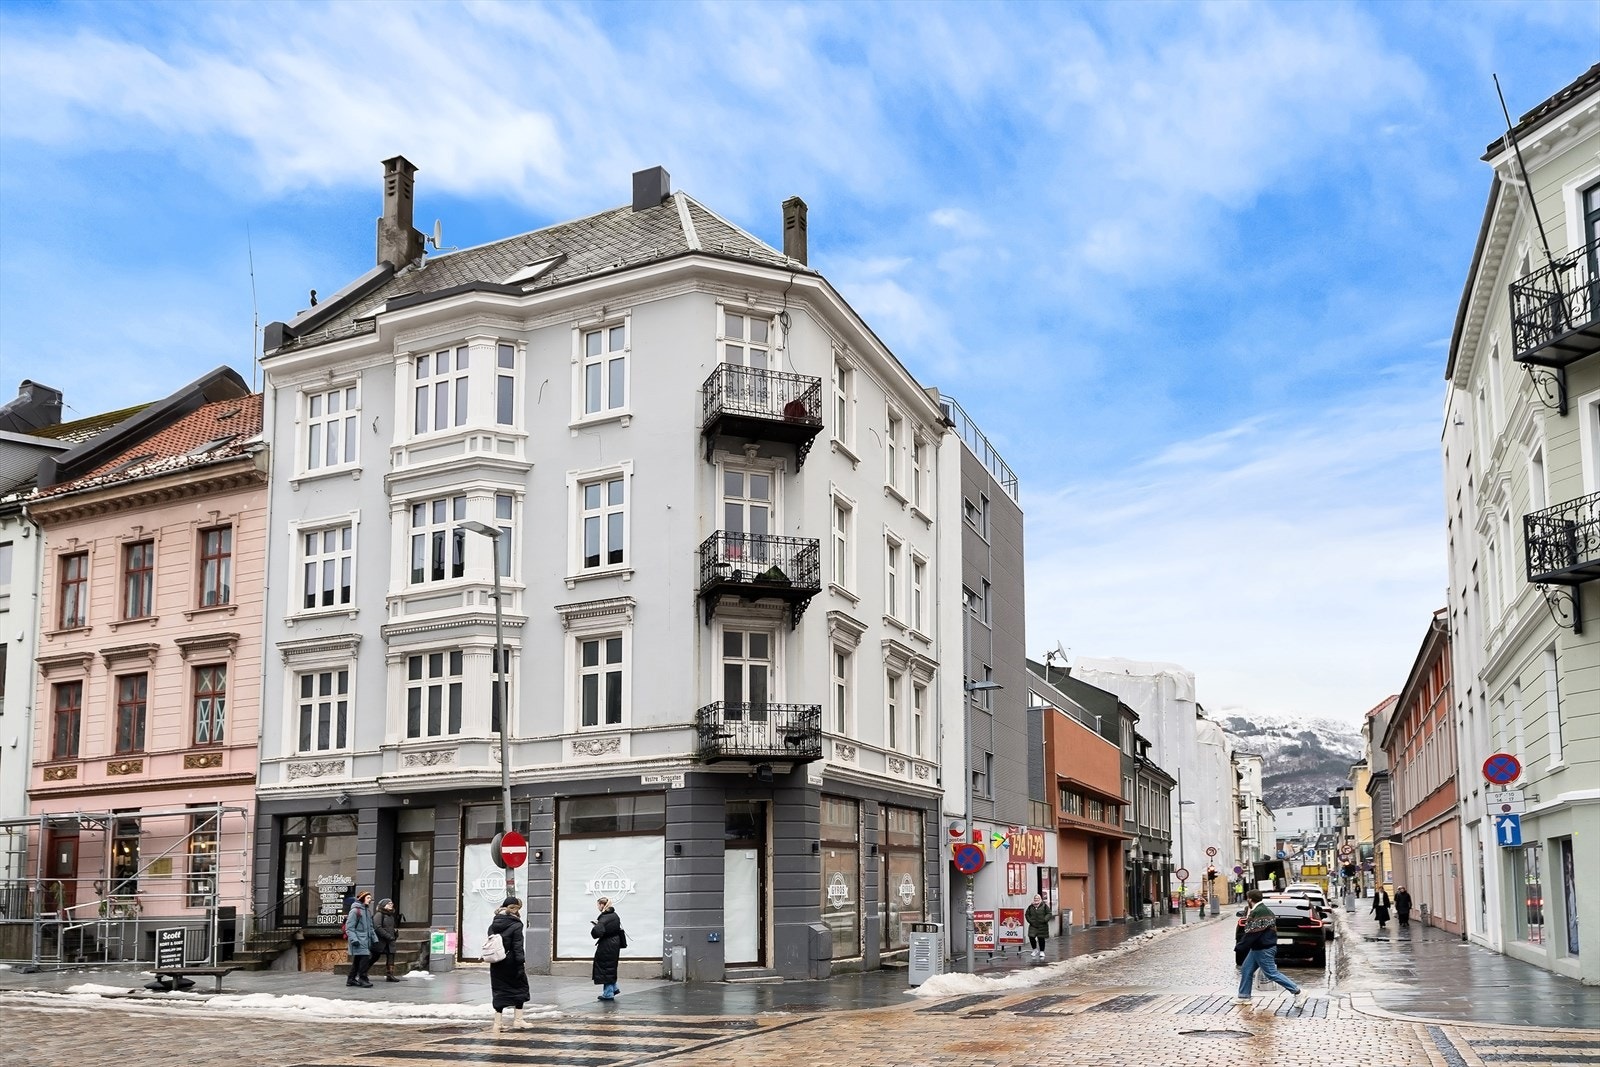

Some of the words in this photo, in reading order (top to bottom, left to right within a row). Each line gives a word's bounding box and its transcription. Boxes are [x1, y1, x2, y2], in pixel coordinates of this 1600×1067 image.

[660, 775, 682, 783] Torggaten
[1011, 834, 1026, 856] 7-24
[1027, 832, 1044, 860] (7-23)
[594, 879, 626, 889] GYROS
[831, 886, 845, 895] GYROS
[317, 914, 338, 925] DROP
[162, 931, 181, 940] Scott
